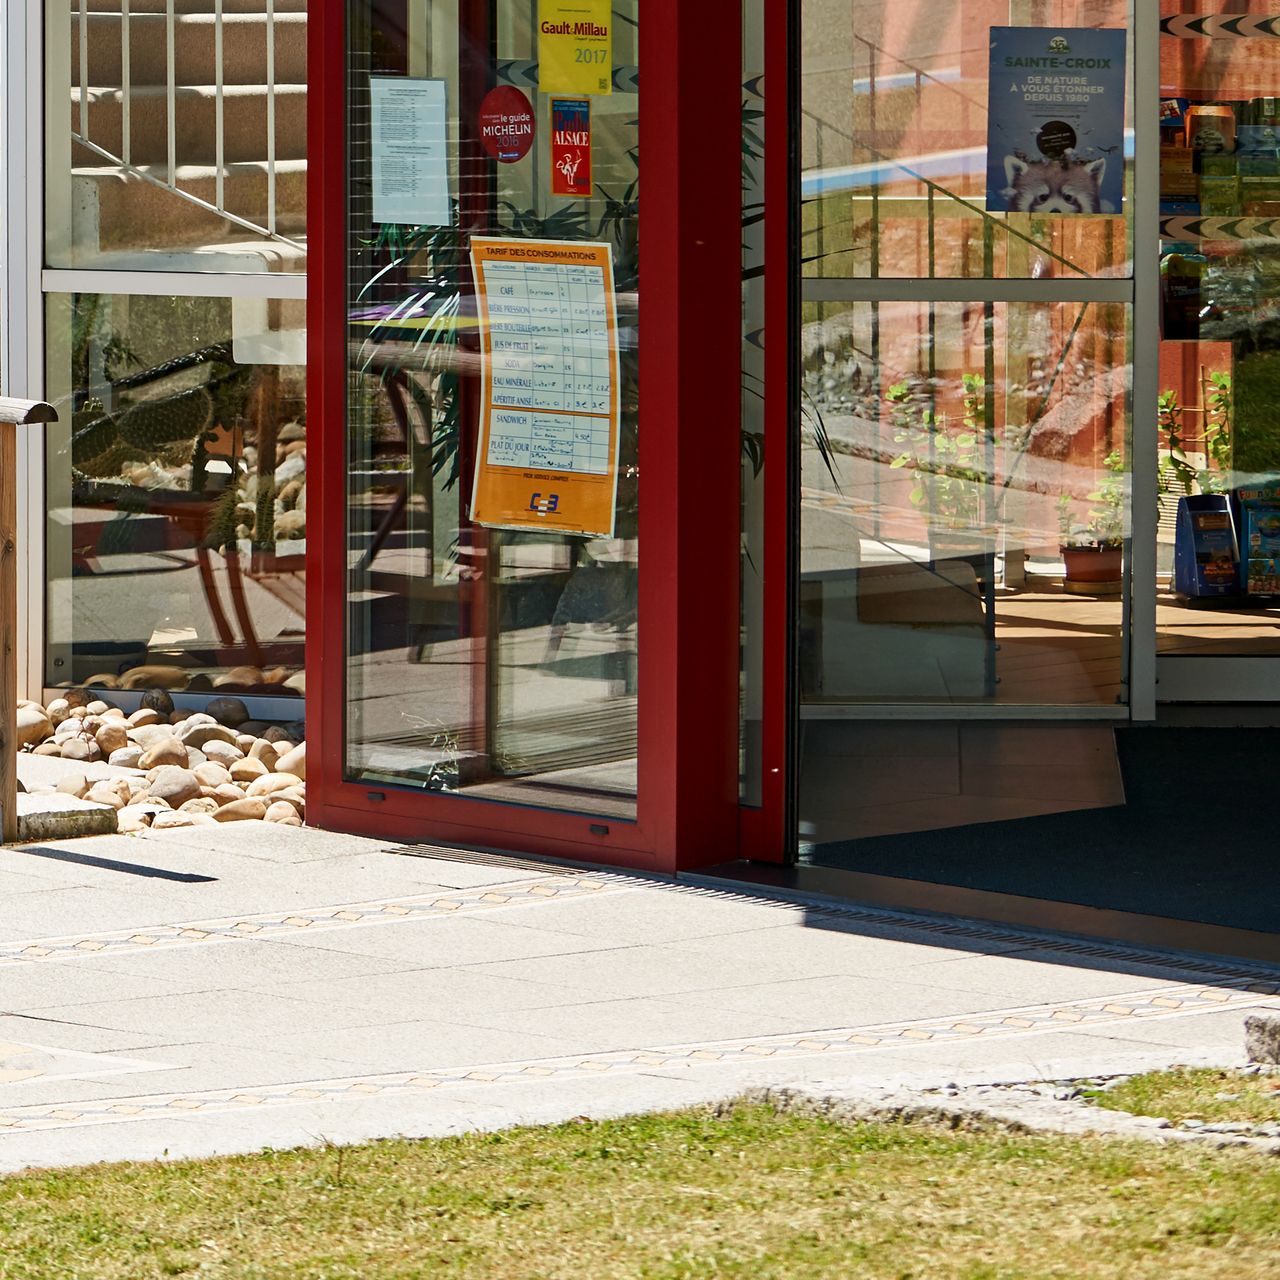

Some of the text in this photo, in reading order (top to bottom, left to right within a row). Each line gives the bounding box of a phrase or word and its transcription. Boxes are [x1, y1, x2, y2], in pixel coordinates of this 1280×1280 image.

[575, 48, 608, 64] 2017
[1004, 56, 1112, 69] SAINTE-CROIX
[1027, 76, 1088, 85] DE NATURE
[1009, 82, 1104, 94] À VOUS ÉTONNER
[1024, 93, 1063, 102] DEPUIS
[500, 114, 508, 123] le
[508, 113, 530, 124] guide
[482, 124, 531, 137] MICHELIN
[496, 135, 519, 148] 2016
[553, 130, 589, 146] ALSACE
[486, 247, 597, 261] TARIF DES CONSOMMATIONS
[504, 304, 530, 314] PRESSION
[493, 376, 505, 386] EAU
[496, 414, 527, 425] SANDWICH
[491, 440, 504, 449] PLAT
[504, 441, 513, 450] DU
[513, 443, 529, 455] JOUR
